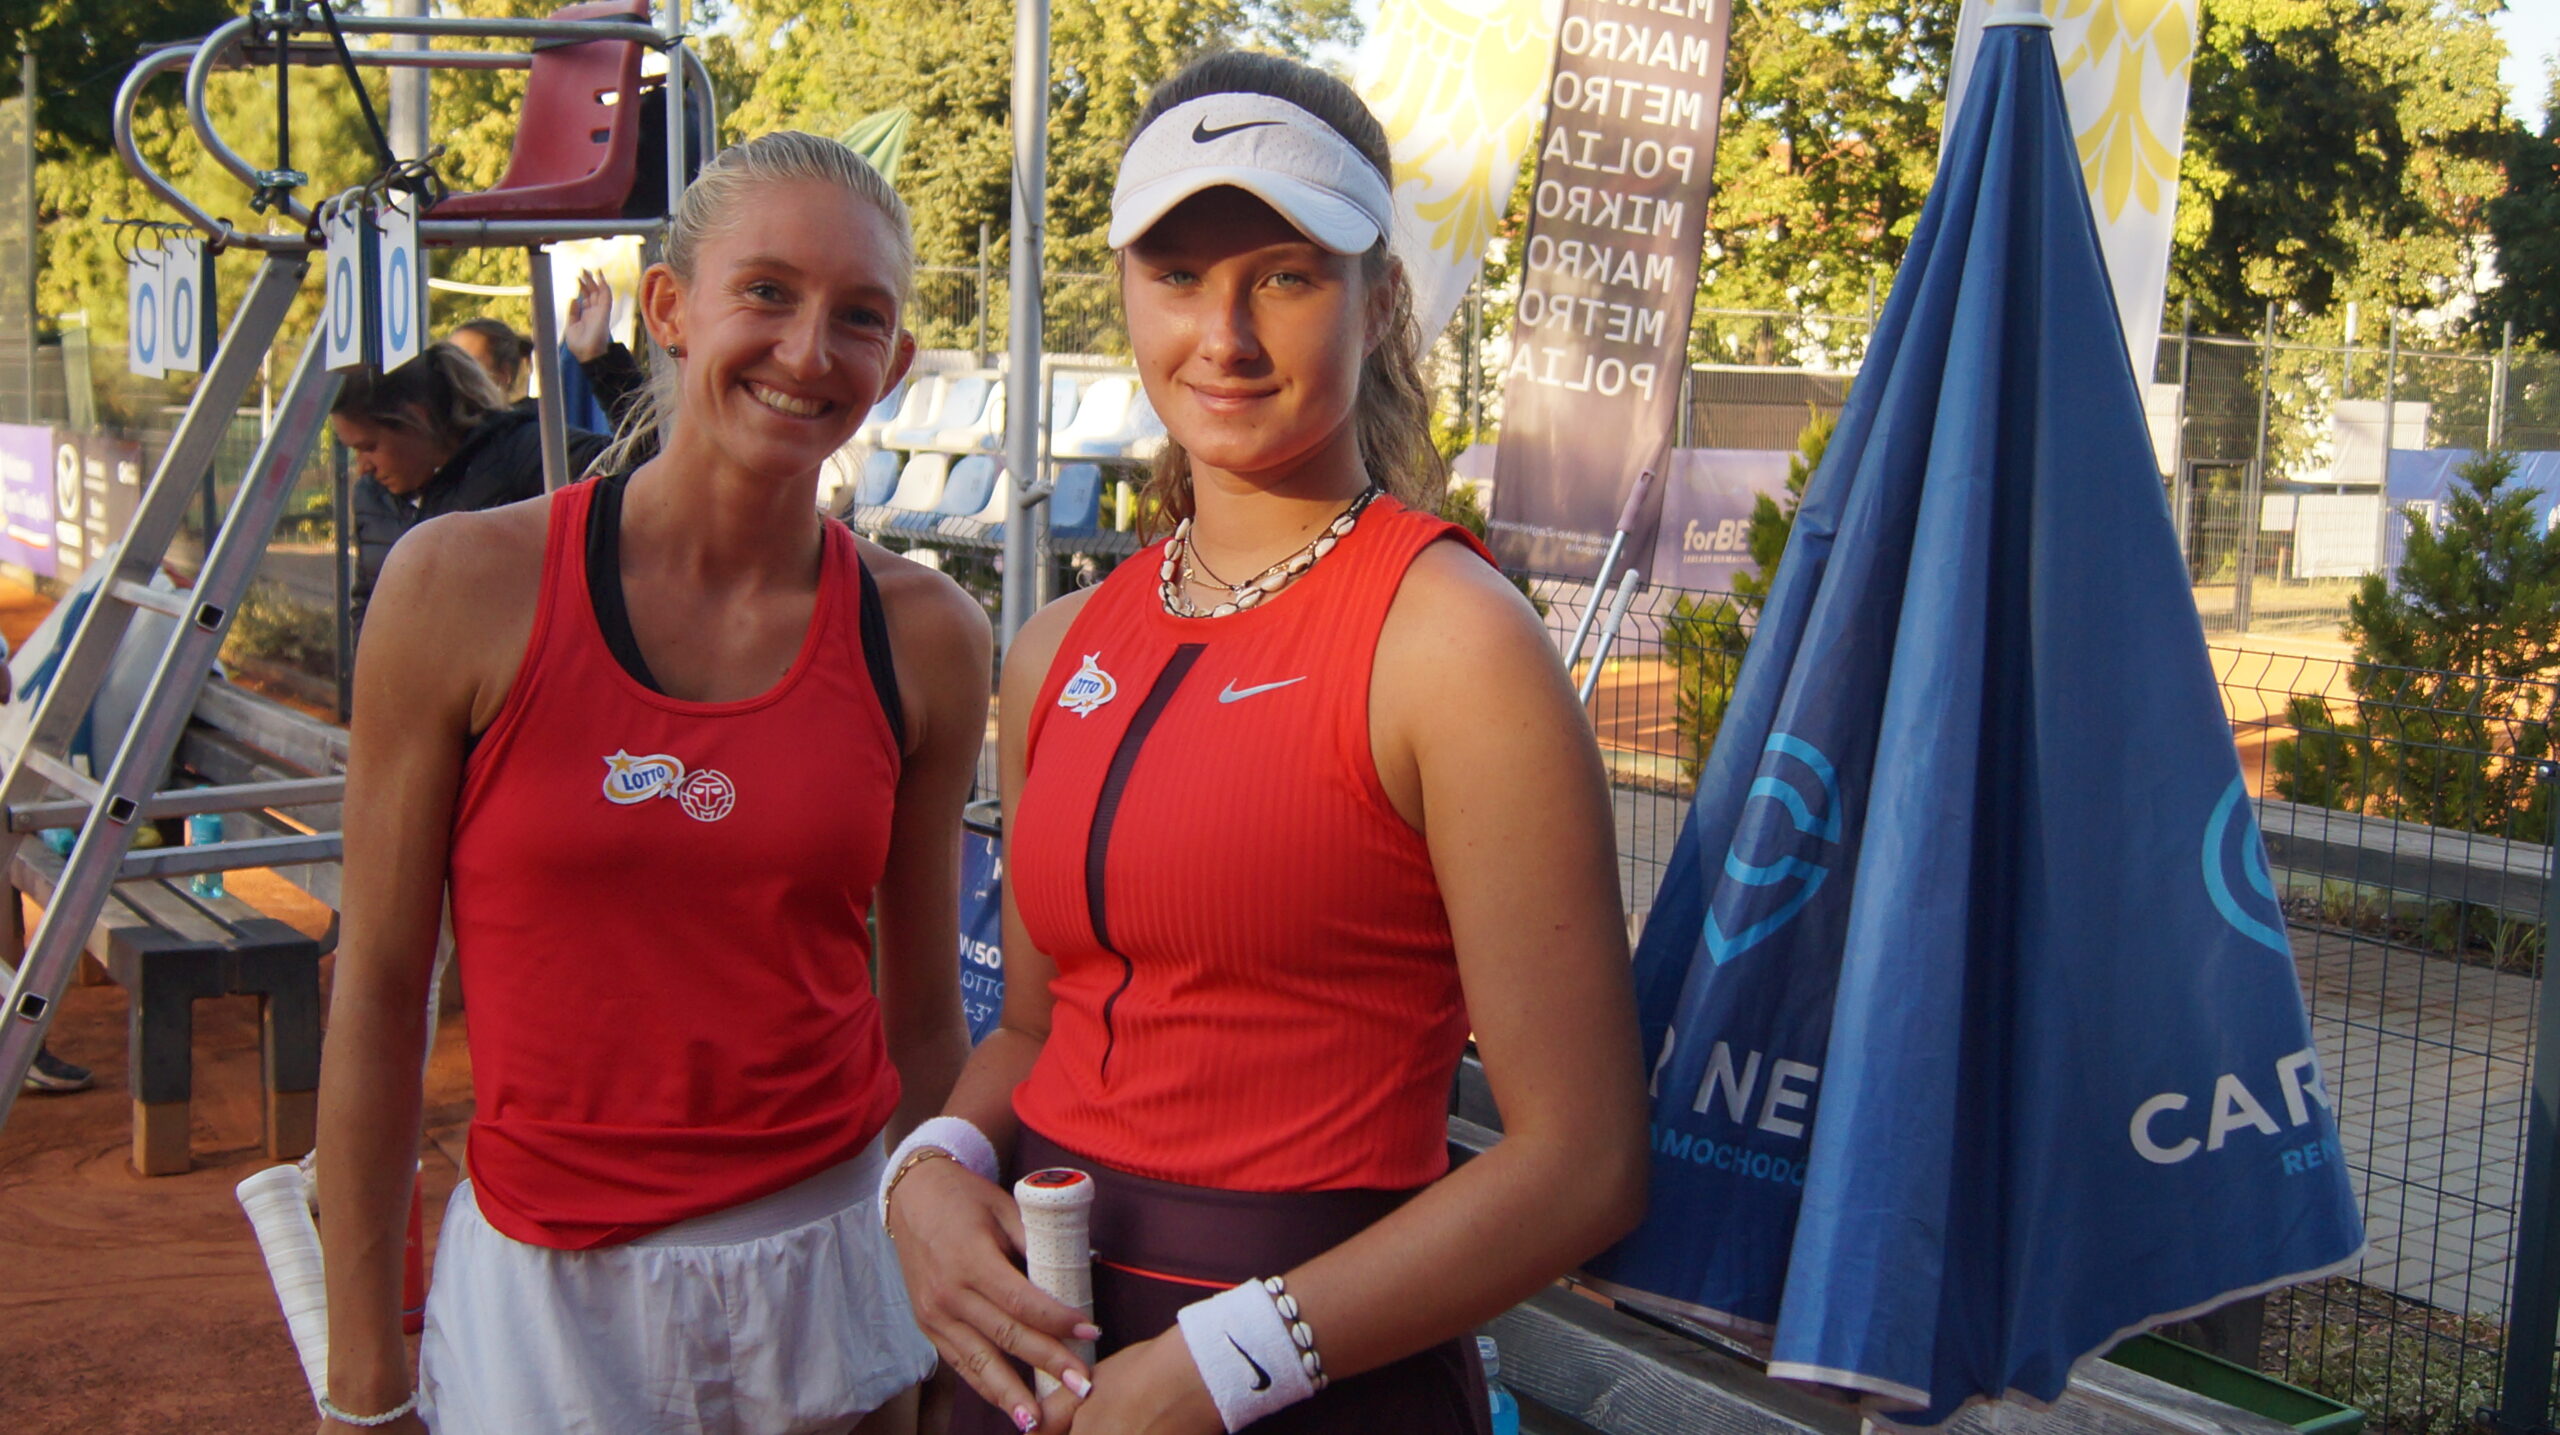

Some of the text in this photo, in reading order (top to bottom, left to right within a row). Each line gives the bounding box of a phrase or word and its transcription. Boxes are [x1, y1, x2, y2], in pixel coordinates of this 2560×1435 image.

[1683, 519, 1751, 551] forBE
[621, 765, 666, 791] LOTTO
[960, 969, 1005, 999] OTT
[1693, 1040, 1819, 1139] NE
[2130, 1047, 2332, 1165] CAR
